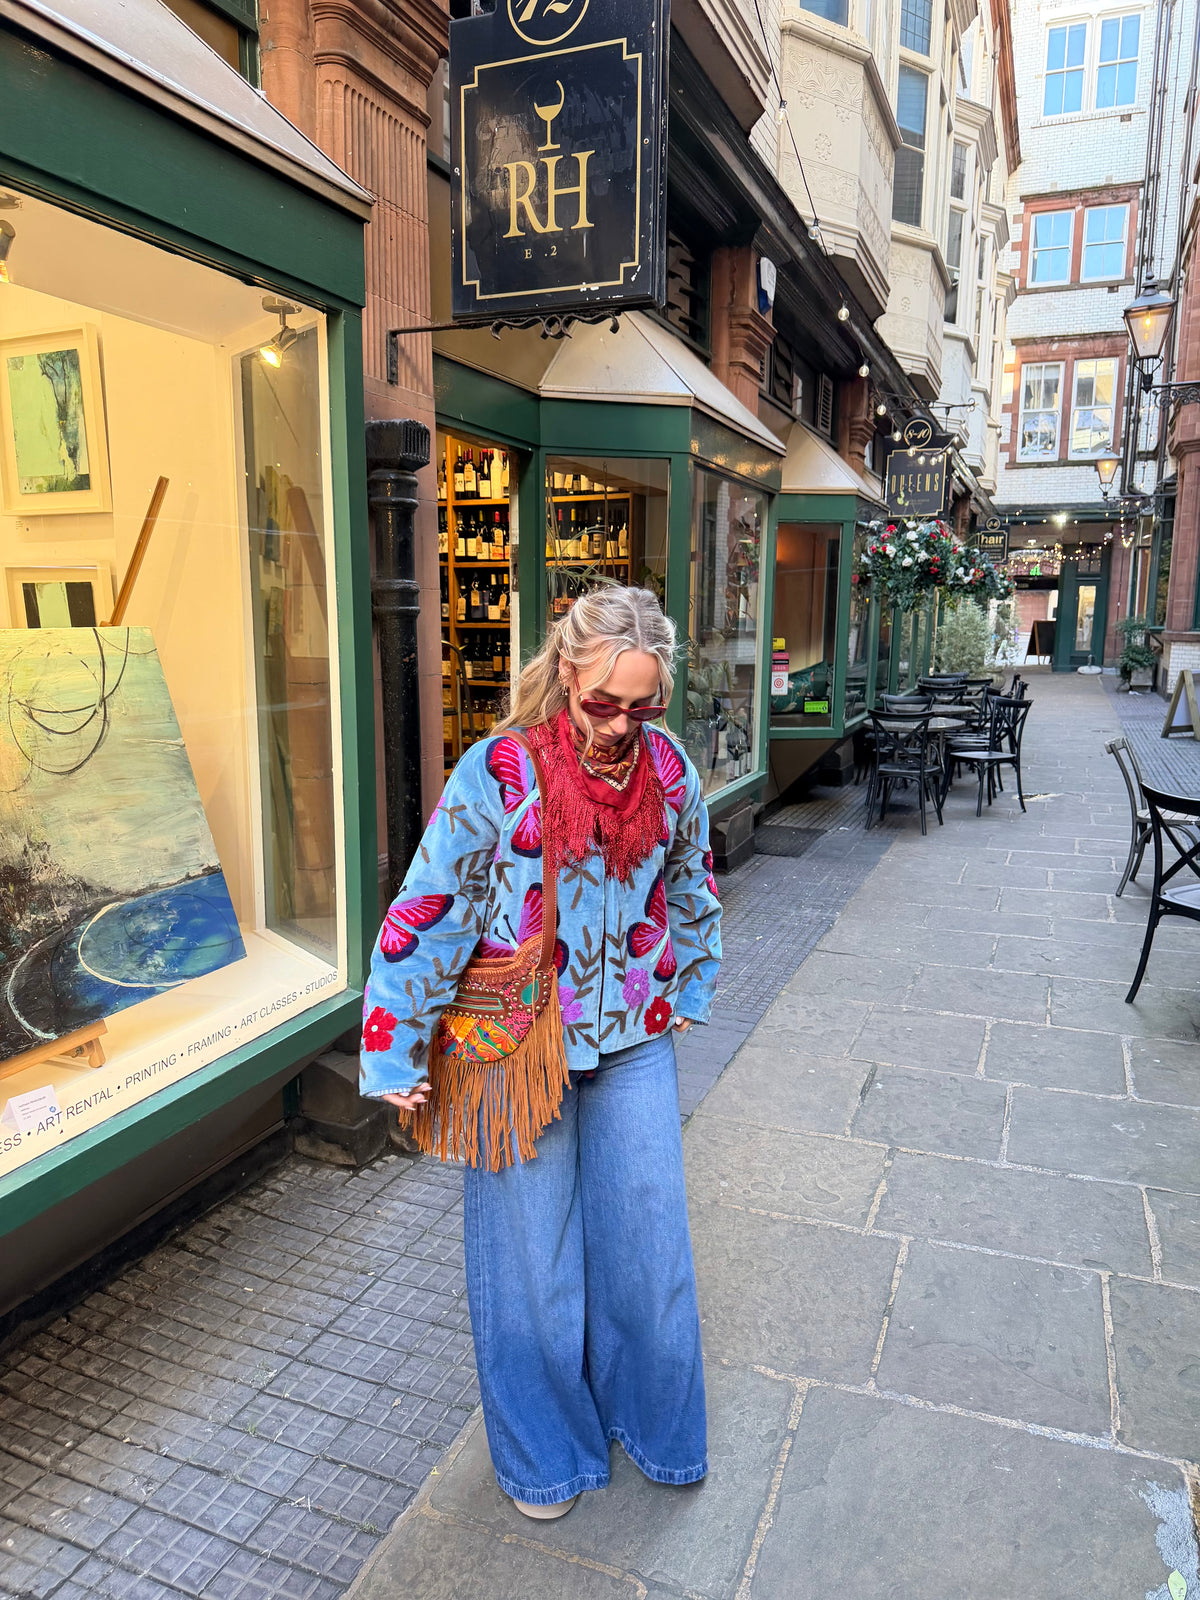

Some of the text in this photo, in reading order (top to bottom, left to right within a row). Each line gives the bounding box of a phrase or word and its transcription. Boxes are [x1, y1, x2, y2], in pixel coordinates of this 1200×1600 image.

[503, 150, 595, 238] RH
[891, 472, 940, 494] QUEENS
[981, 534, 1004, 545] hair
[36, 1111, 63, 1136] ART
[66, 1087, 114, 1120] RENTAL
[124, 1053, 178, 1090] PRINTING
[187, 1025, 232, 1057] FRAMING
[239, 1011, 258, 1030] ART
[259, 991, 298, 1019] CLASSES
[304, 971, 338, 996] STUDIOS
